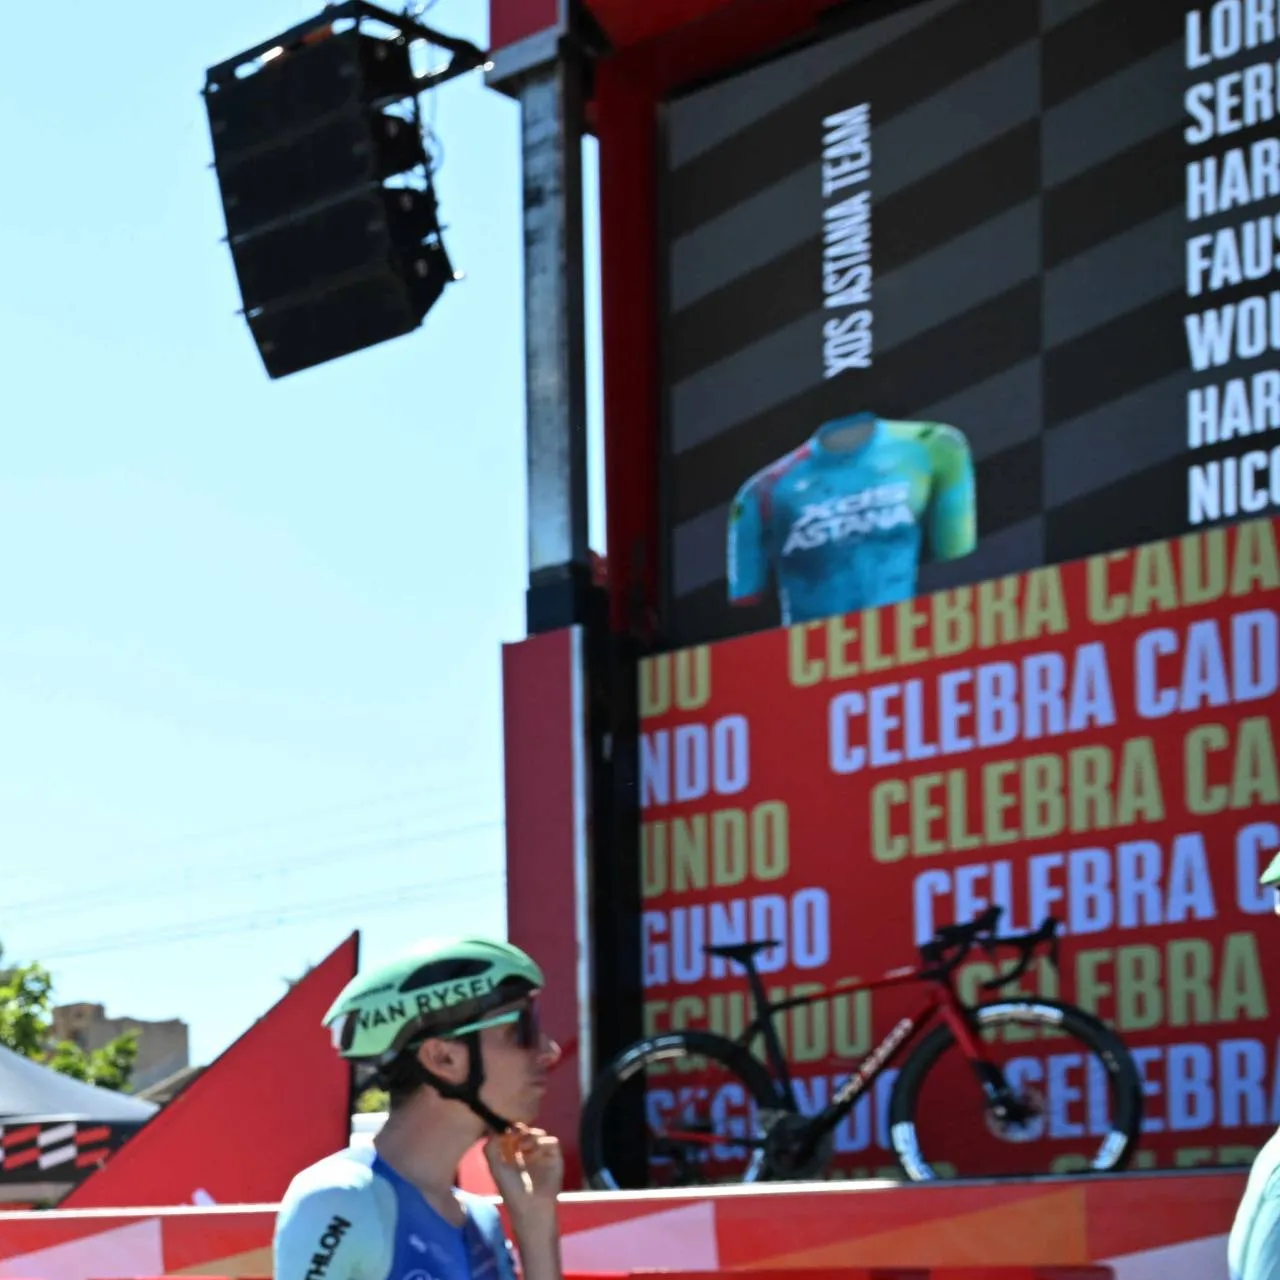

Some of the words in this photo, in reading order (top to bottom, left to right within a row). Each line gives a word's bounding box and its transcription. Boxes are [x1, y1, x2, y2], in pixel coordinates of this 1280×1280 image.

[822, 102, 871, 197] TEAM
[823, 190, 872, 308] ASTANA
[823, 309, 873, 379] XDS
[829, 641, 1116, 774] CELEBRA
[870, 736, 1165, 862] CELEBRA
[356, 1000, 406, 1031] VAN
